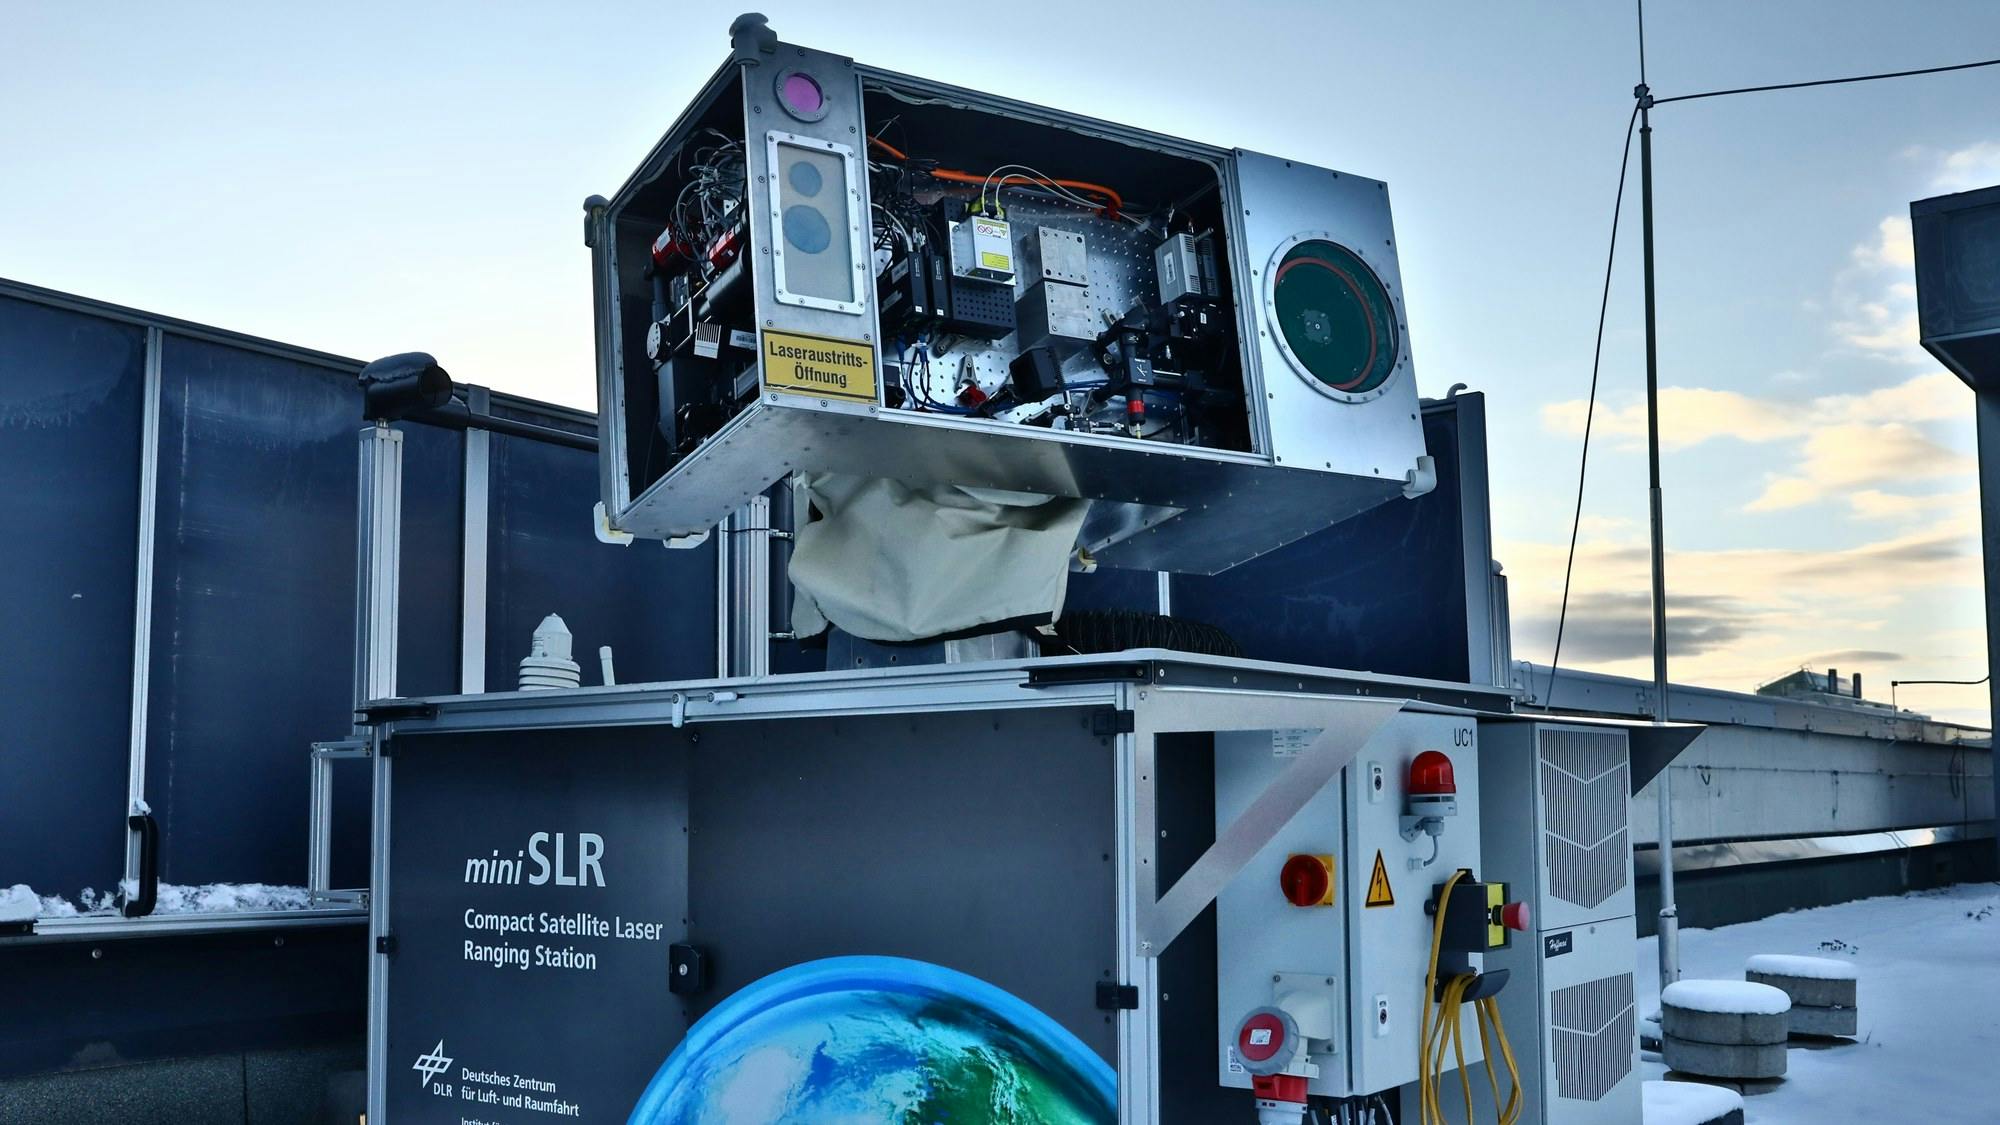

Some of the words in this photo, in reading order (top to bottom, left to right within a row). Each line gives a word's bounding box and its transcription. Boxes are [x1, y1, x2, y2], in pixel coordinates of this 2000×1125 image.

[770, 341, 868, 368] Laseraustritts-
[794, 361, 847, 388] Öffnung
[1454, 728, 1473, 747] UC1
[464, 908, 535, 936] Compact
[539, 912, 610, 937] Satellite
[615, 916, 664, 940] Laser
[464, 940, 529, 970] Ranging
[535, 945, 596, 970] Station
[433, 1082, 453, 1097] DLR
[462, 1067, 511, 1087] Deutsches
[513, 1074, 556, 1093] Zentrum
[461, 1085, 476, 1101] für
[477, 1088, 500, 1105] Luft-
[502, 1094, 522, 1108] und
[524, 1096, 579, 1117] Raumfahrt
